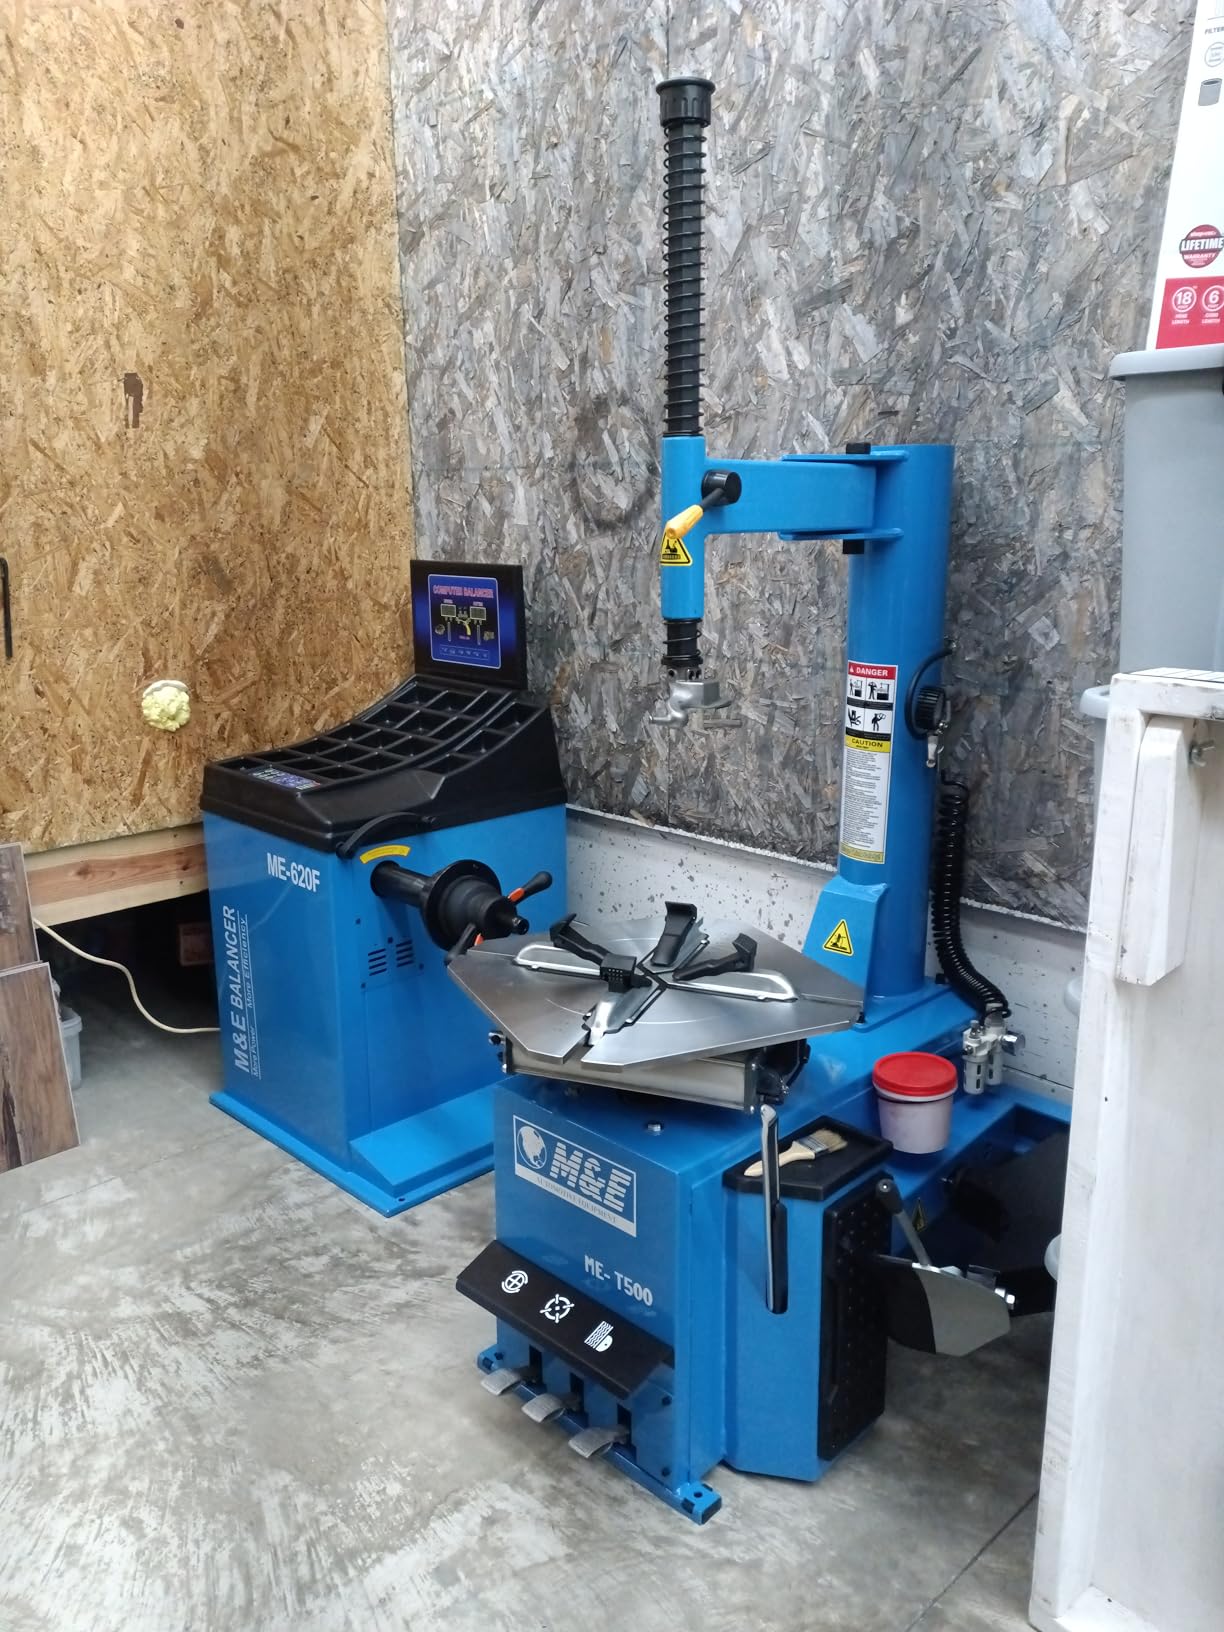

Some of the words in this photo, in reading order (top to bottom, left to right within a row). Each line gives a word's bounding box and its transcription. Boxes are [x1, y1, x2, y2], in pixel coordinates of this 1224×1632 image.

[1181, 238, 1224, 251] LIFETIME
[1176, 291, 1192, 305] 18
[1209, 290, 1220, 304] 6
[856, 666, 888, 677] DANGER
[851, 738, 883, 748] CAUTION
[266, 852, 321, 893] ME-620F
[222, 905, 243, 1010] BALANCER
[244, 982, 253, 1009] More
[230, 1011, 250, 1073] M&E
[248, 1026, 257, 1055] Power
[550, 1141, 632, 1213] M&E
[614, 1270, 653, 1306] T500
